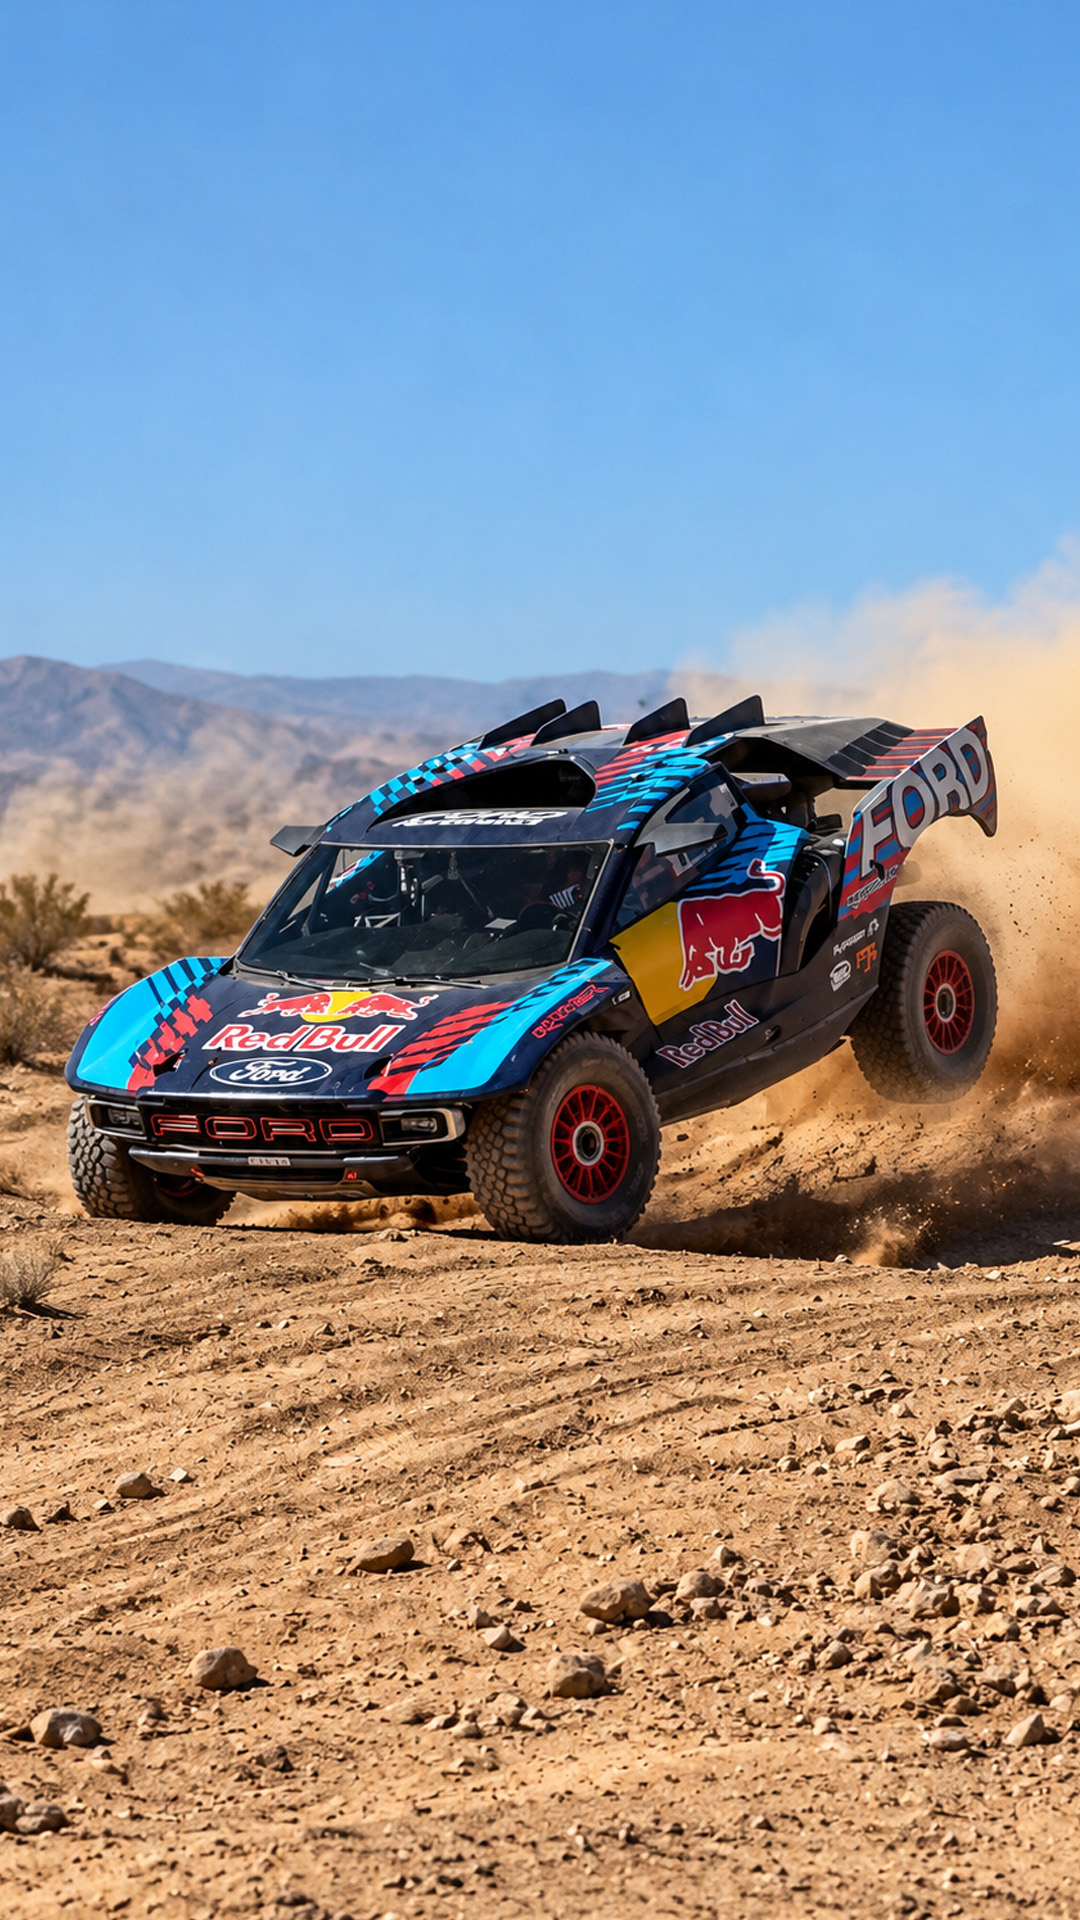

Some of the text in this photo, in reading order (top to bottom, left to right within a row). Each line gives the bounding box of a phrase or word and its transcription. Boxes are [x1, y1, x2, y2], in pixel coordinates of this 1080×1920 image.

[861, 727, 989, 878] FORD
[229, 1061, 311, 1082] Ford
[151, 1114, 374, 1142] FORD
